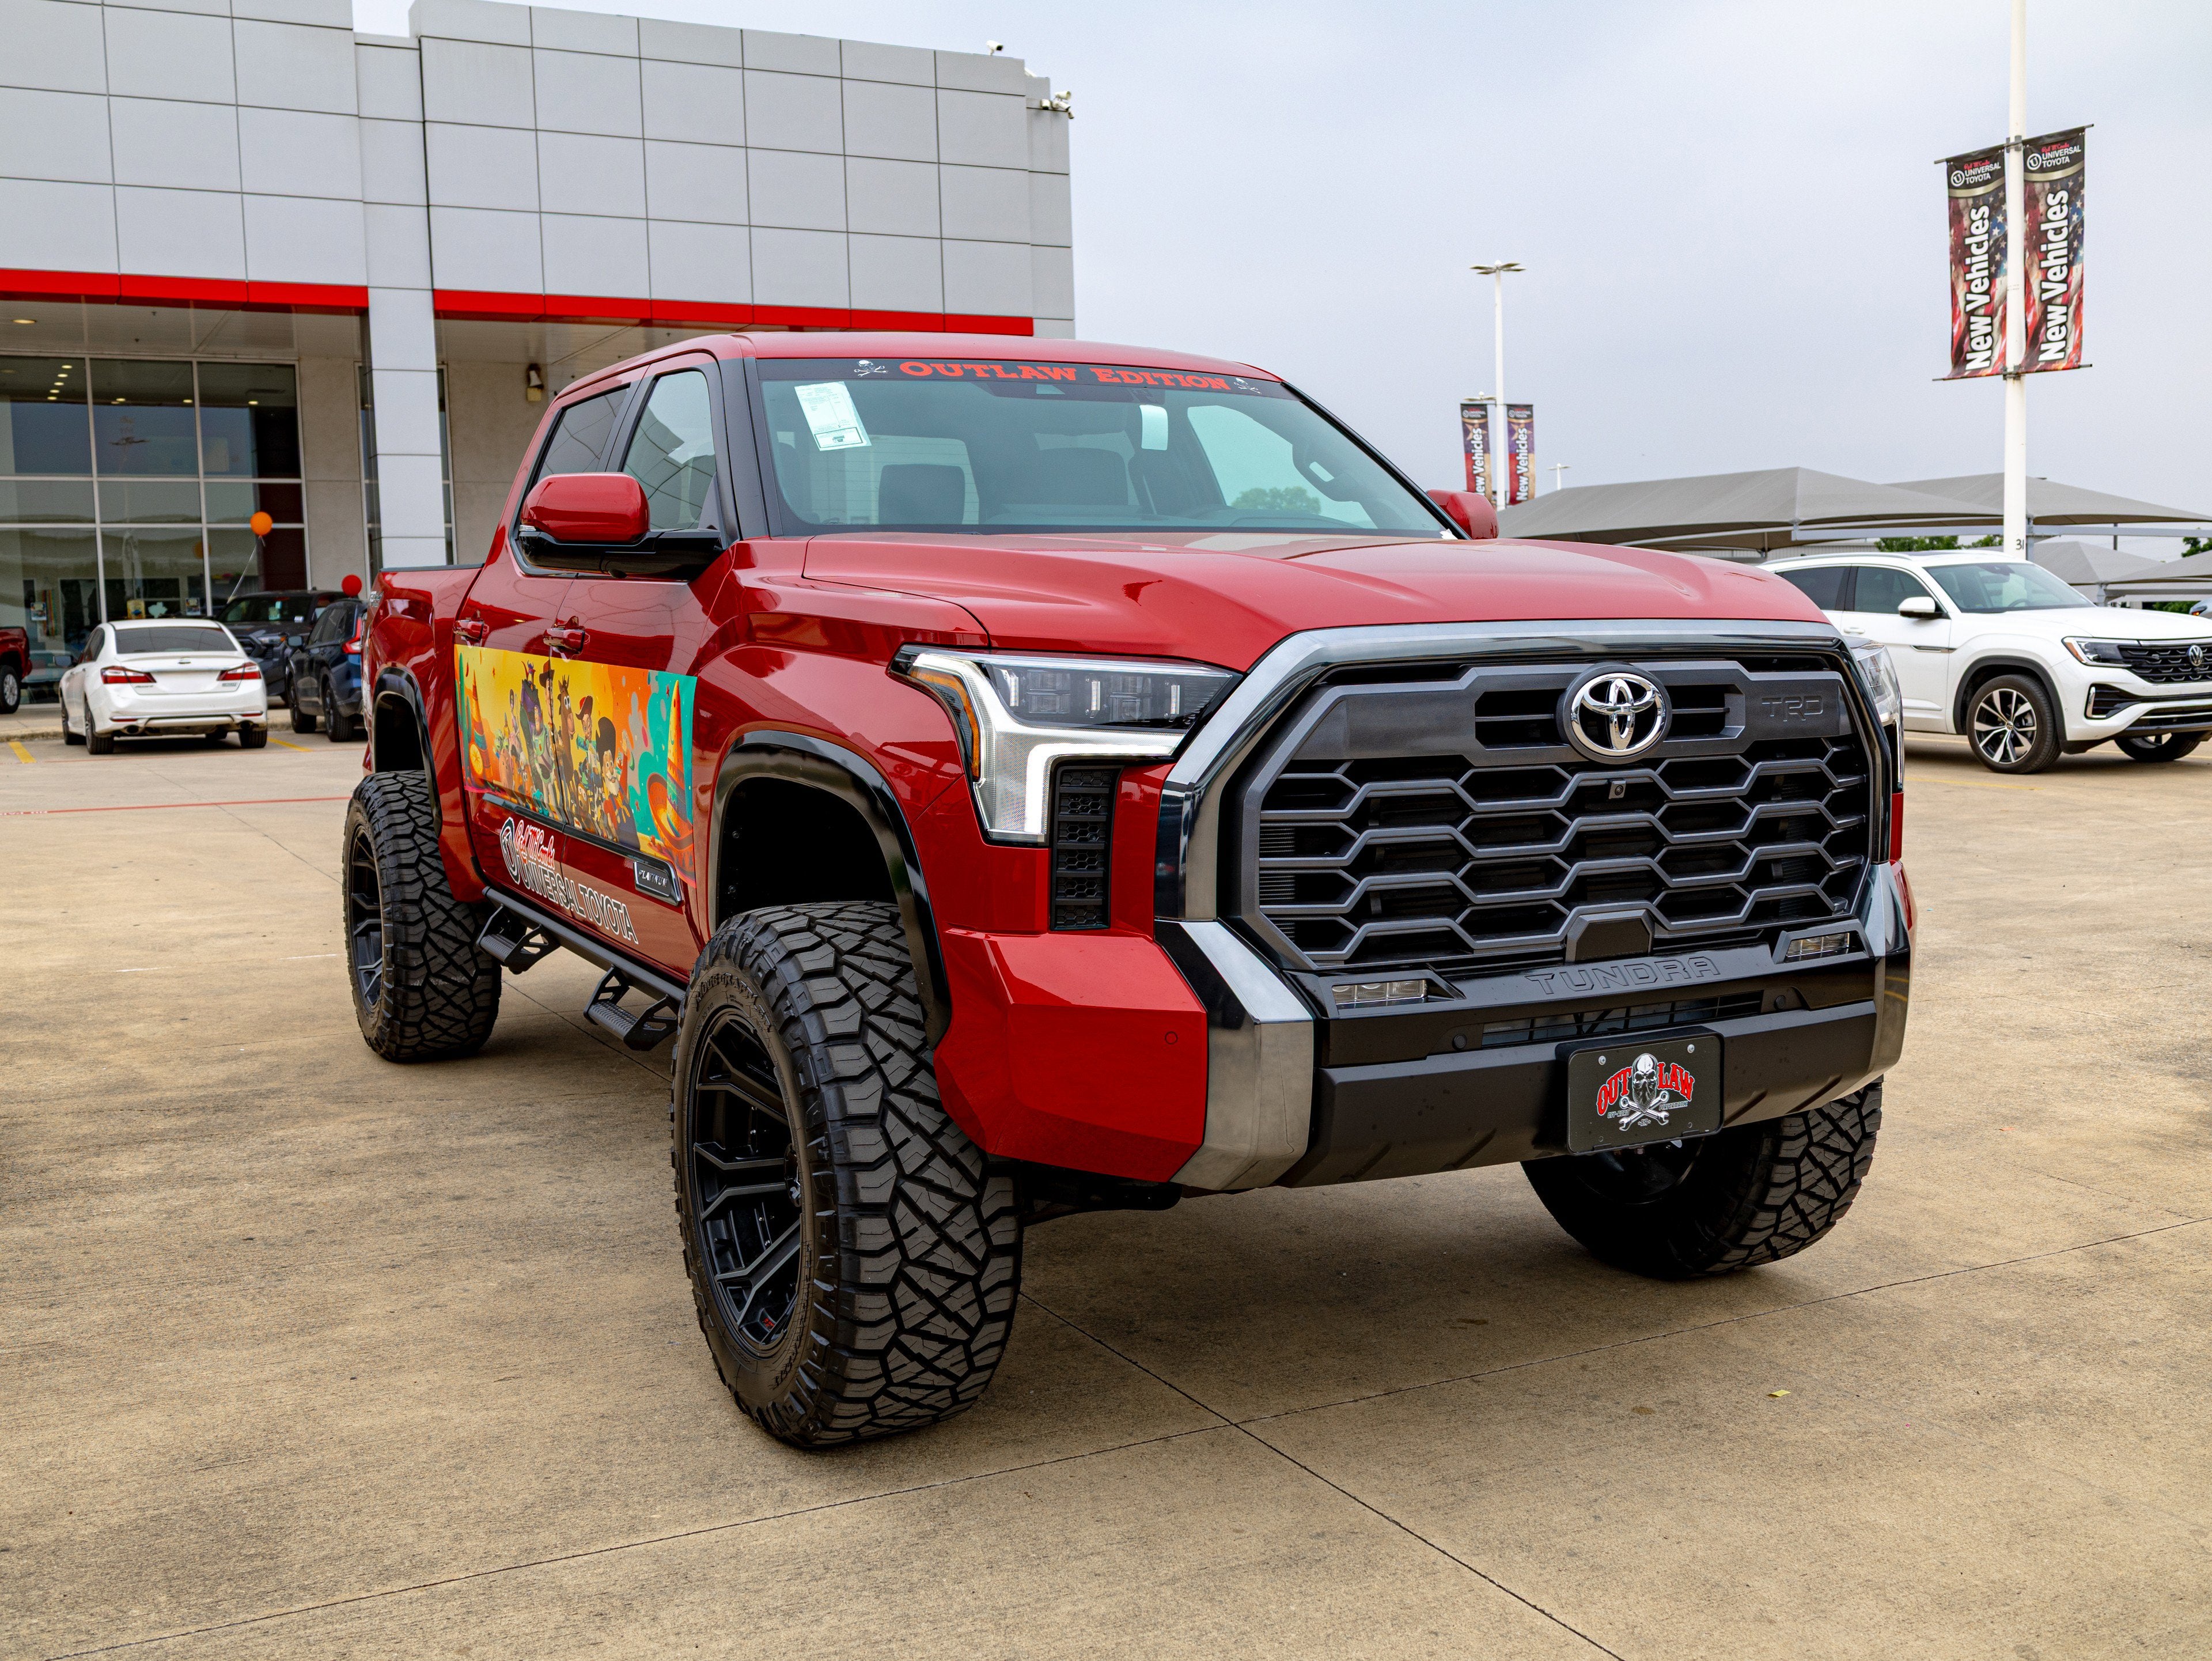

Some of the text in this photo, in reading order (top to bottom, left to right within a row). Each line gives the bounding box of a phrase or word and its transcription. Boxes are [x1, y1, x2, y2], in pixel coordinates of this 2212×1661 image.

[2041, 145, 2081, 160] UNIVERSAL
[2042, 157, 2070, 168] TOYOTA
[1964, 162, 2001, 177] UNIVERSAL
[1965, 173, 1991, 184] TOYOTA
[1965, 205, 1993, 371] New Vehicles
[2038, 190, 2069, 362] New Vehicles
[899, 361, 1231, 390] OUTLAW EDITION
[1471, 428, 1484, 474] Vehicles
[1516, 427, 1528, 474] Vehicles
[1516, 476, 1528, 501] New
[2016, 539, 2024, 550] 31
[1762, 696, 1823, 721] TRD
[639, 869, 668, 887] PLATINUM
[516, 855, 639, 944] UNIVERSAL TOYOTA
[1524, 956, 1720, 995] TUNDRA
[1607, 1110, 1630, 1118] OFF-ROAD
